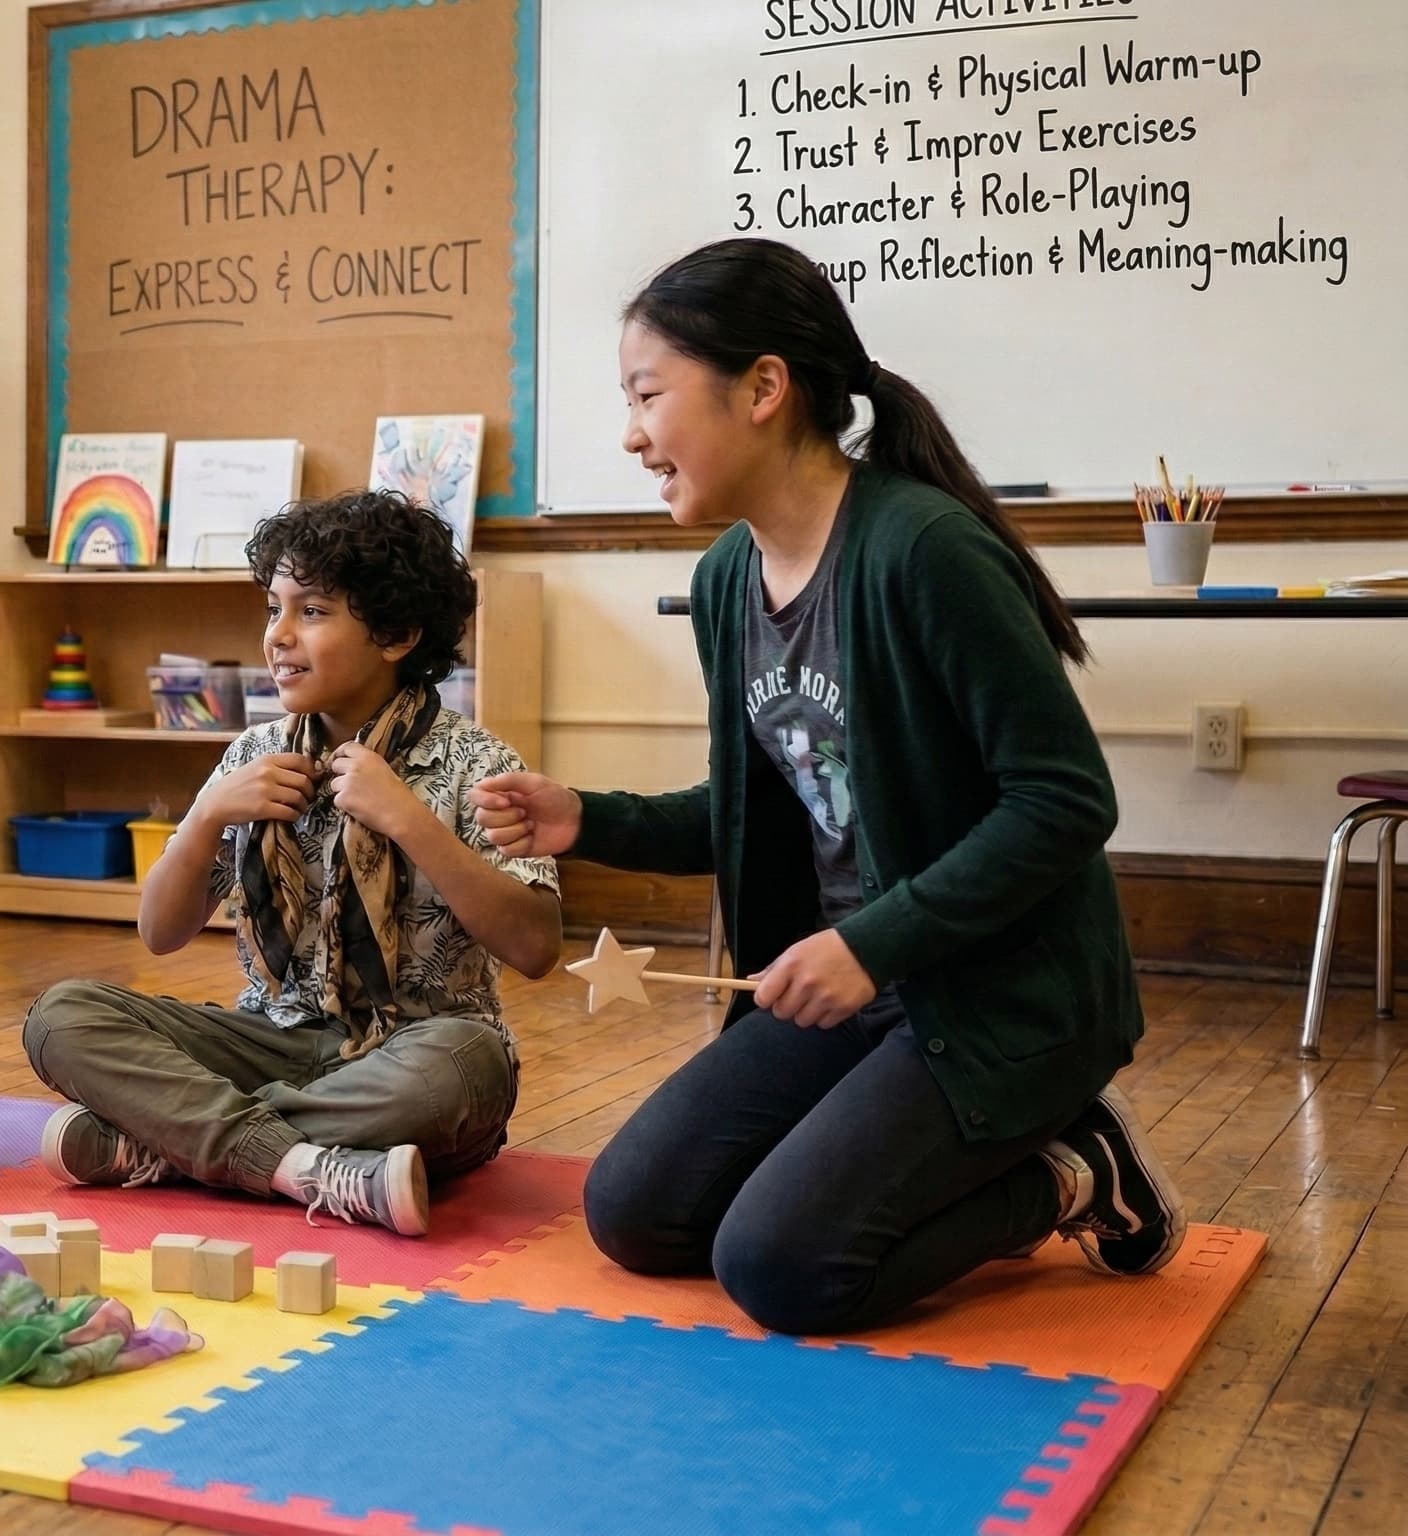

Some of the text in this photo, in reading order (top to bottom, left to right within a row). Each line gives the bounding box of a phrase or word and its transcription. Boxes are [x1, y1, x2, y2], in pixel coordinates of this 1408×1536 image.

[765, 0, 915, 40] SESSION
[131, 67, 325, 158] DRAMA
[738, 40, 1261, 117] 1. Check-in & Physical Warm-up
[733, 109, 1197, 178] 2. Trust & Improv Exercises
[166, 149, 394, 225] THERAPY:
[734, 167, 1190, 231] 3. Character & Role-Playing
[110, 240, 482, 317] EXPRESS & CONNECT
[814, 216, 1348, 304] oup Reflection & Meaning-making
